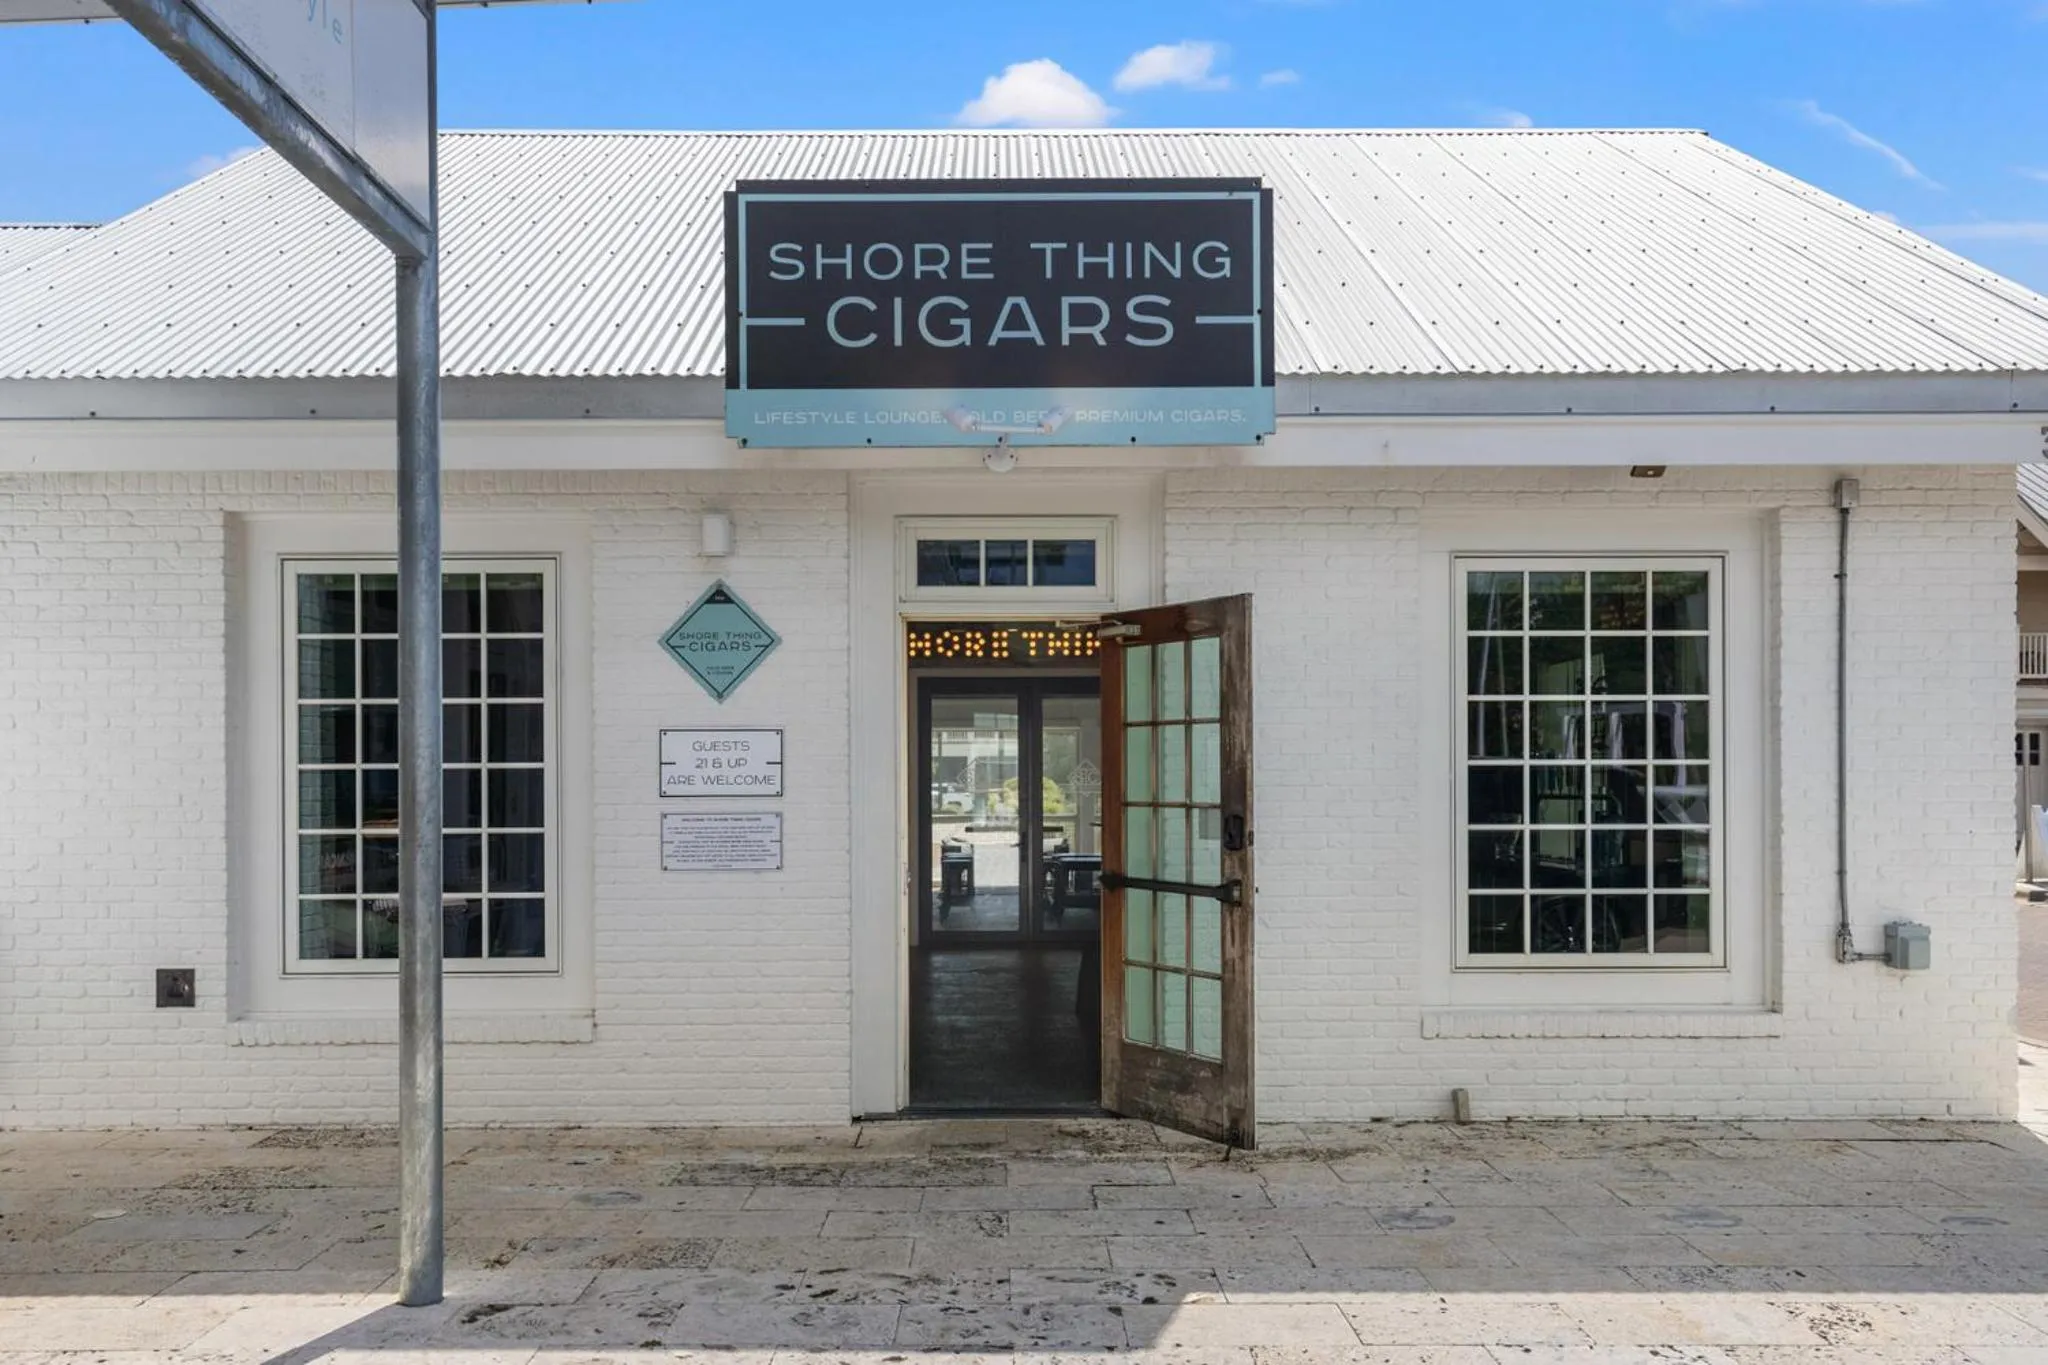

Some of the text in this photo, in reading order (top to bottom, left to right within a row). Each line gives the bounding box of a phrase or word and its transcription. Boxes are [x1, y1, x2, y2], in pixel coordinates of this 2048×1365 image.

[768, 240, 1232, 280] SHORE THING
[826, 294, 1175, 348] CIGARS
[754, 411, 857, 425] LIFESTYLE
[864, 410, 948, 425] LOUNGE.
[969, 410, 1006, 424] OLD
[1074, 409, 1164, 424] PREMIUM
[1170, 409, 1247, 423] CIGARS.
[679, 631, 761, 640] SHORE THING
[688, 641, 752, 652] CIGARS
[692, 740, 751, 752] GUESTS
[695, 757, 747, 769] 21 & UP
[667, 774, 776, 786] ARE WELCOME
